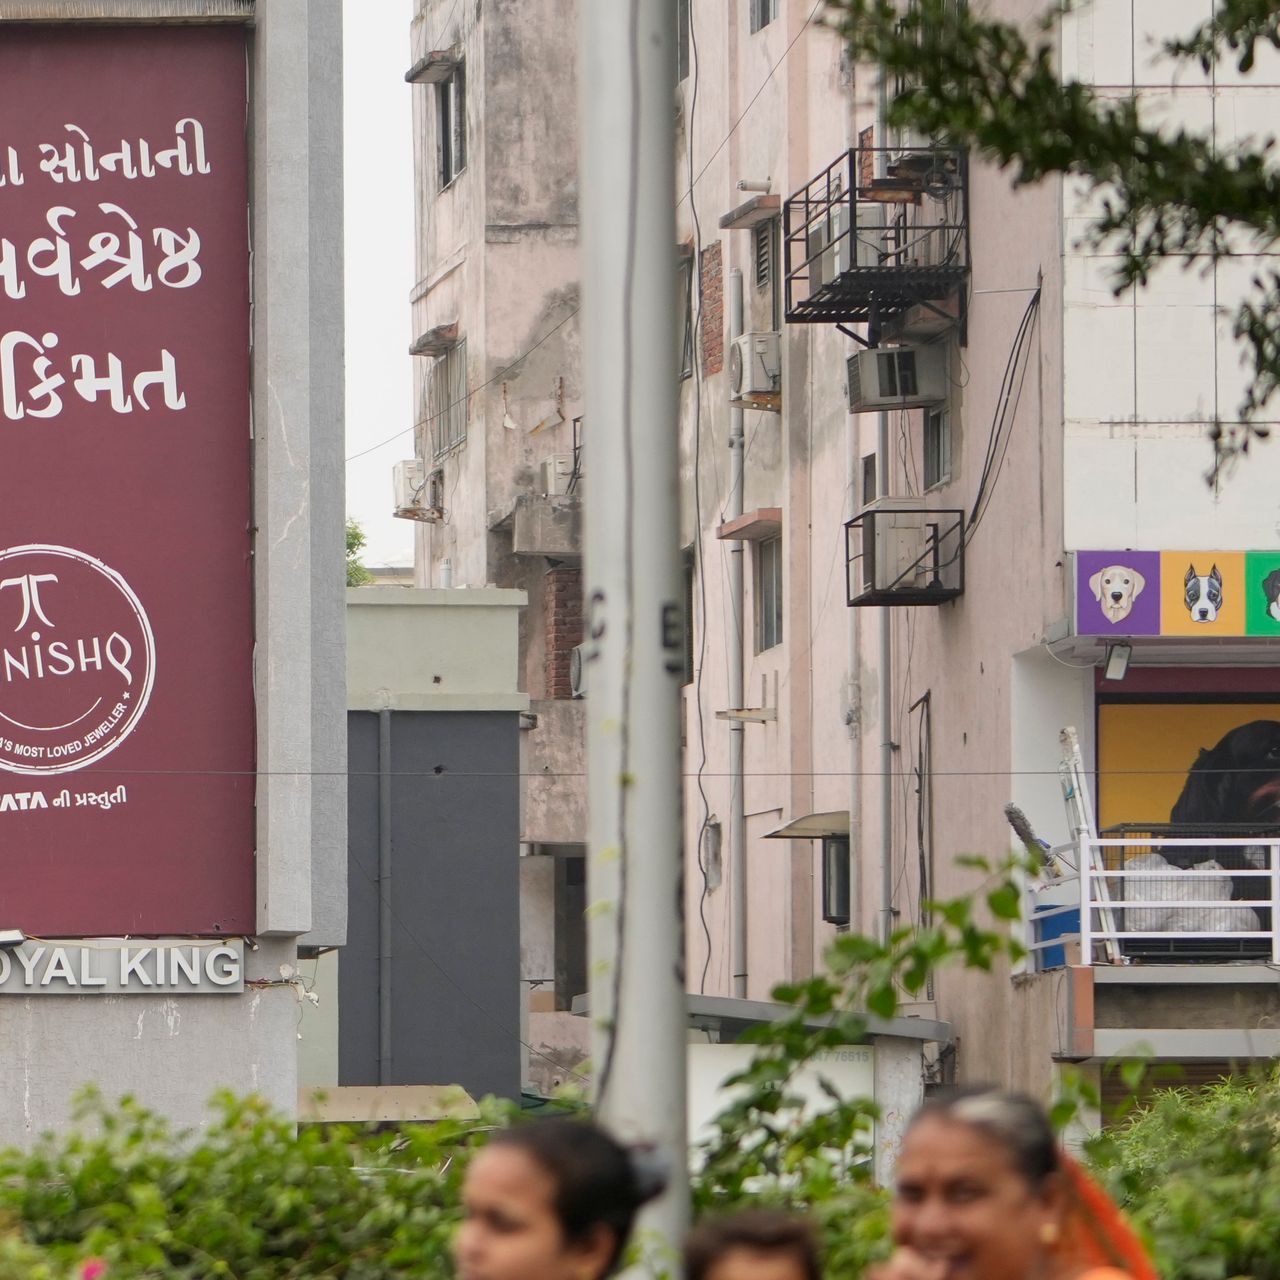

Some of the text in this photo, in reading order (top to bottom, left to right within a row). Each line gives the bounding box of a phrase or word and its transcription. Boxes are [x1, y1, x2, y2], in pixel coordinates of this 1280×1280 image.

[38, 117, 211, 184] સોનાની
[0, 330, 187, 421] કિંમત
[13, 743, 45, 758] MOST
[46, 740, 83, 758] LOVED
[83, 701, 128, 748] JEWELLER
[52, 789, 71, 808] ની
[119, 946, 241, 986] KING
